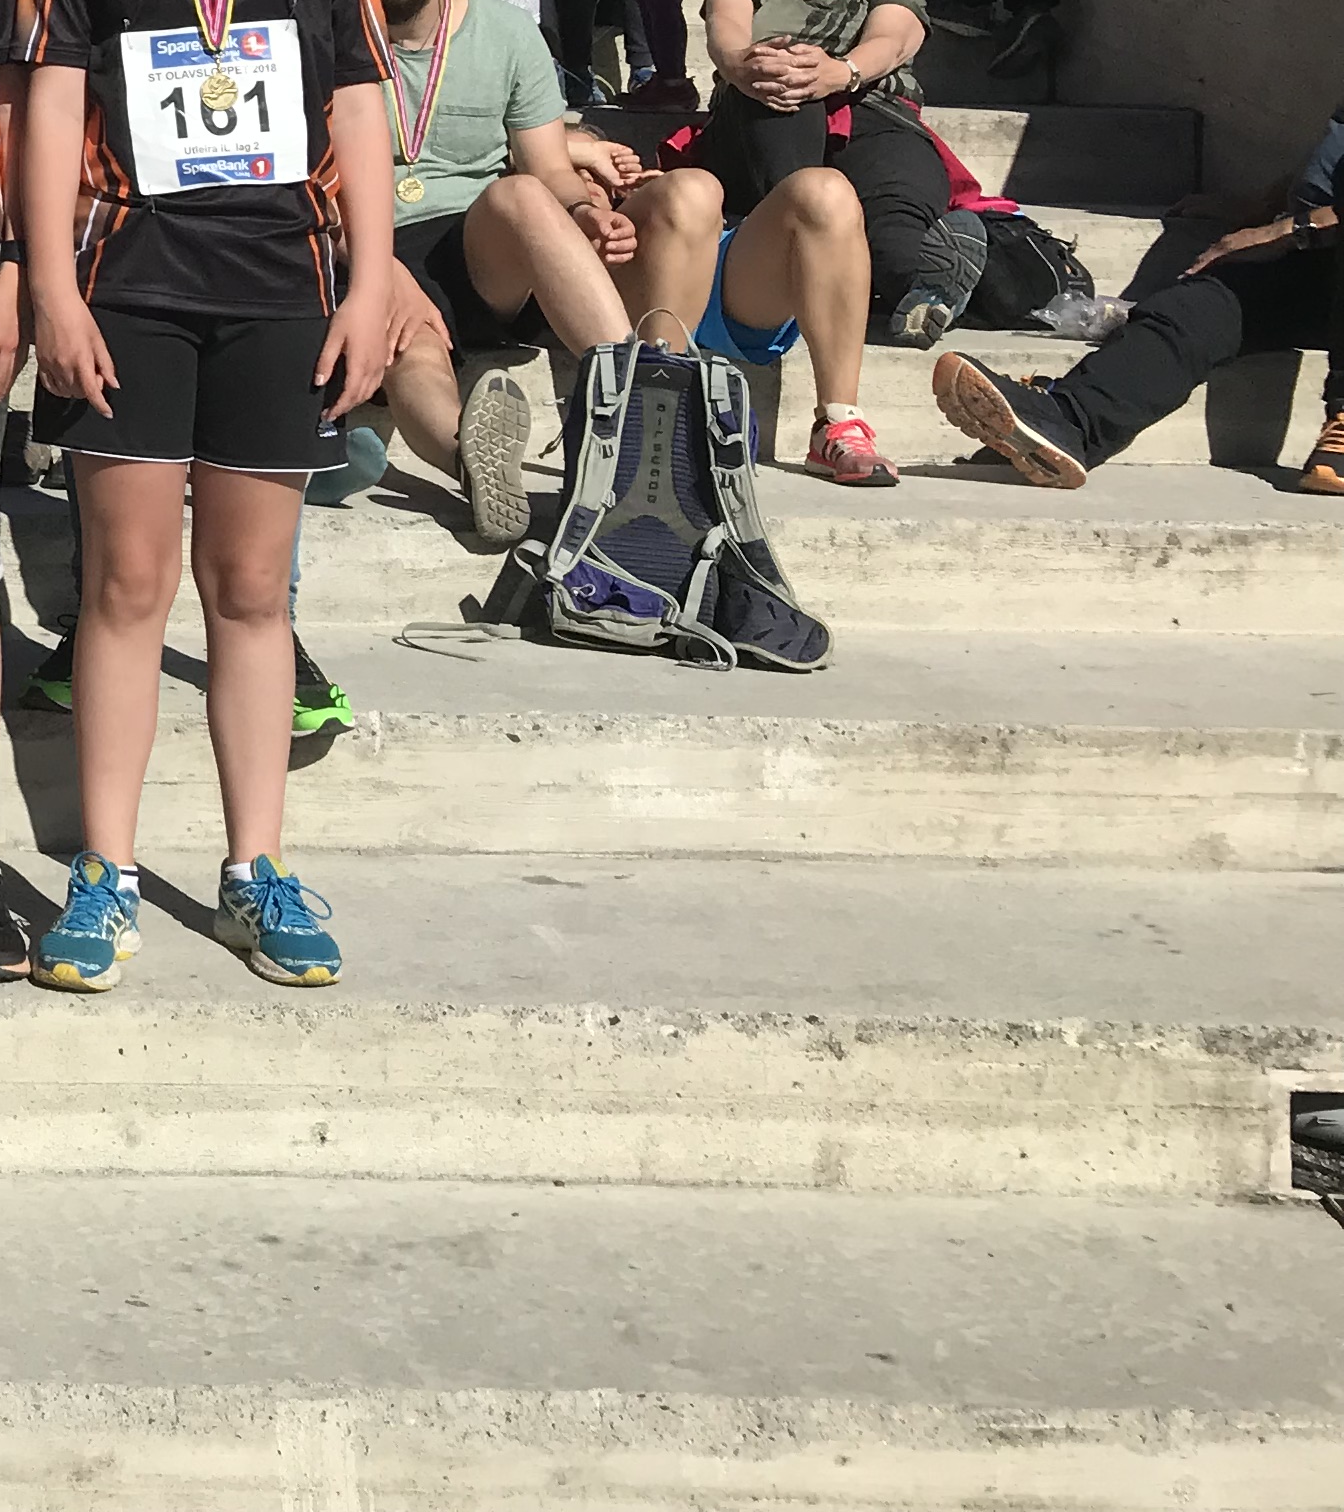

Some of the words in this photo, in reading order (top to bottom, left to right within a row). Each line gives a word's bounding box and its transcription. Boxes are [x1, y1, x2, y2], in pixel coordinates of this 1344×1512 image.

[148, 72, 162, 82] ST
[160, 80, 270, 139] 161
[235, 143, 251, 152] lag
[253, 141, 260, 150] 2
